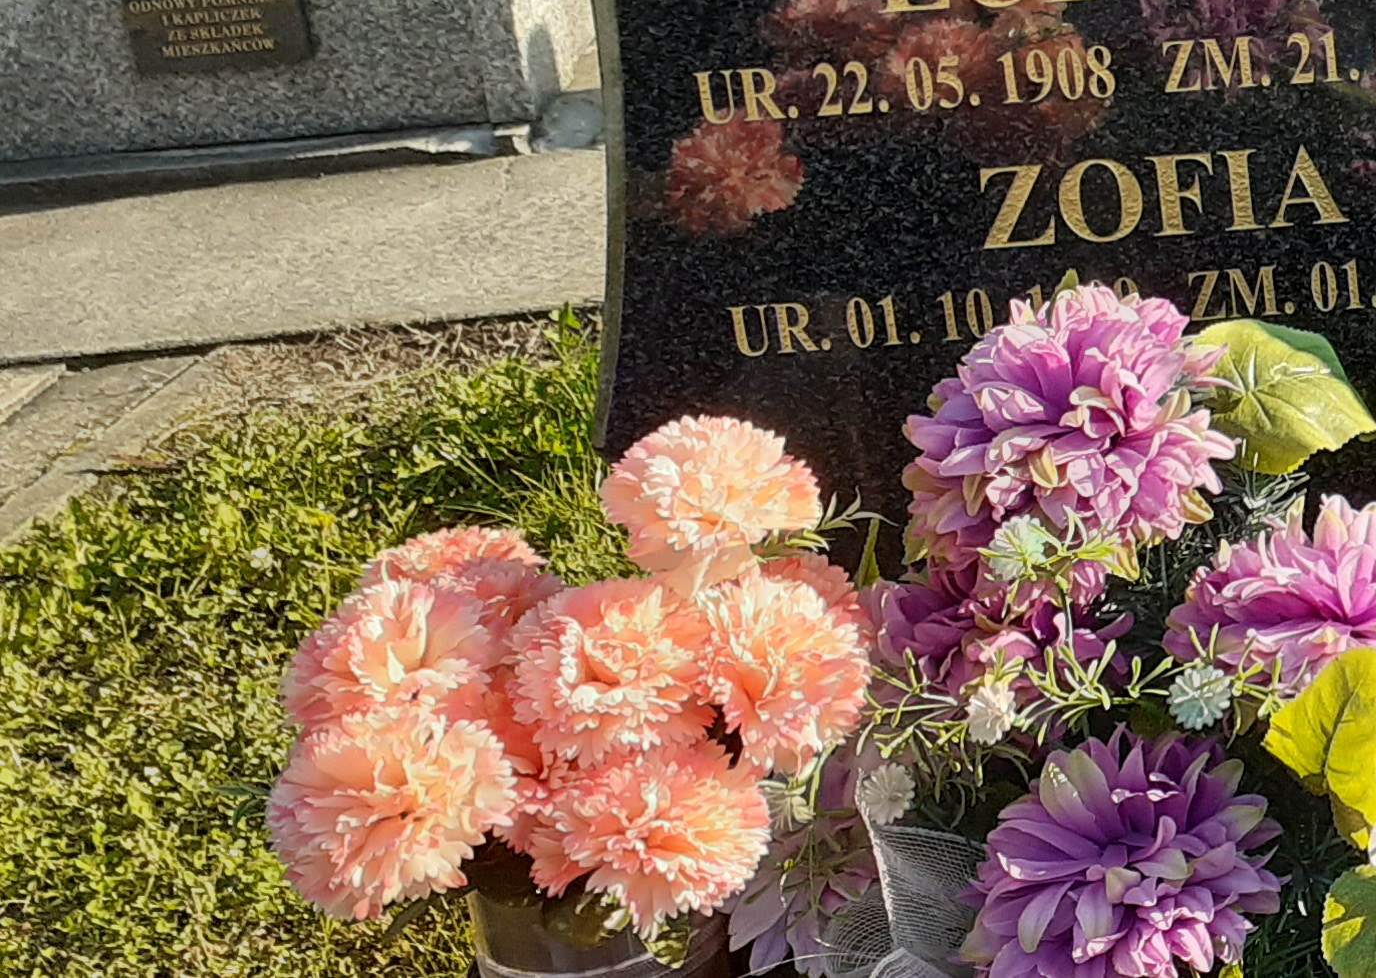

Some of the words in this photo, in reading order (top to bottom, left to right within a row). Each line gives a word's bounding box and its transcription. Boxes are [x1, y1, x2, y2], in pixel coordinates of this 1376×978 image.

[172, 7, 264, 27] KAPLICZEK
[694, 68, 799, 124] UR.
[812, 61, 891, 117] 22.
[904, 54, 981, 112] 05.
[997, 44, 1117, 106] 1908
[1160, 35, 1271, 94] ZM.
[1287, 29, 1360, 85] 21.
[978, 142, 1350, 251] ZOFIA
[726, 299, 832, 357] UR.
[845, 294, 920, 350] 01.
[1187, 262, 1297, 322] ZM.
